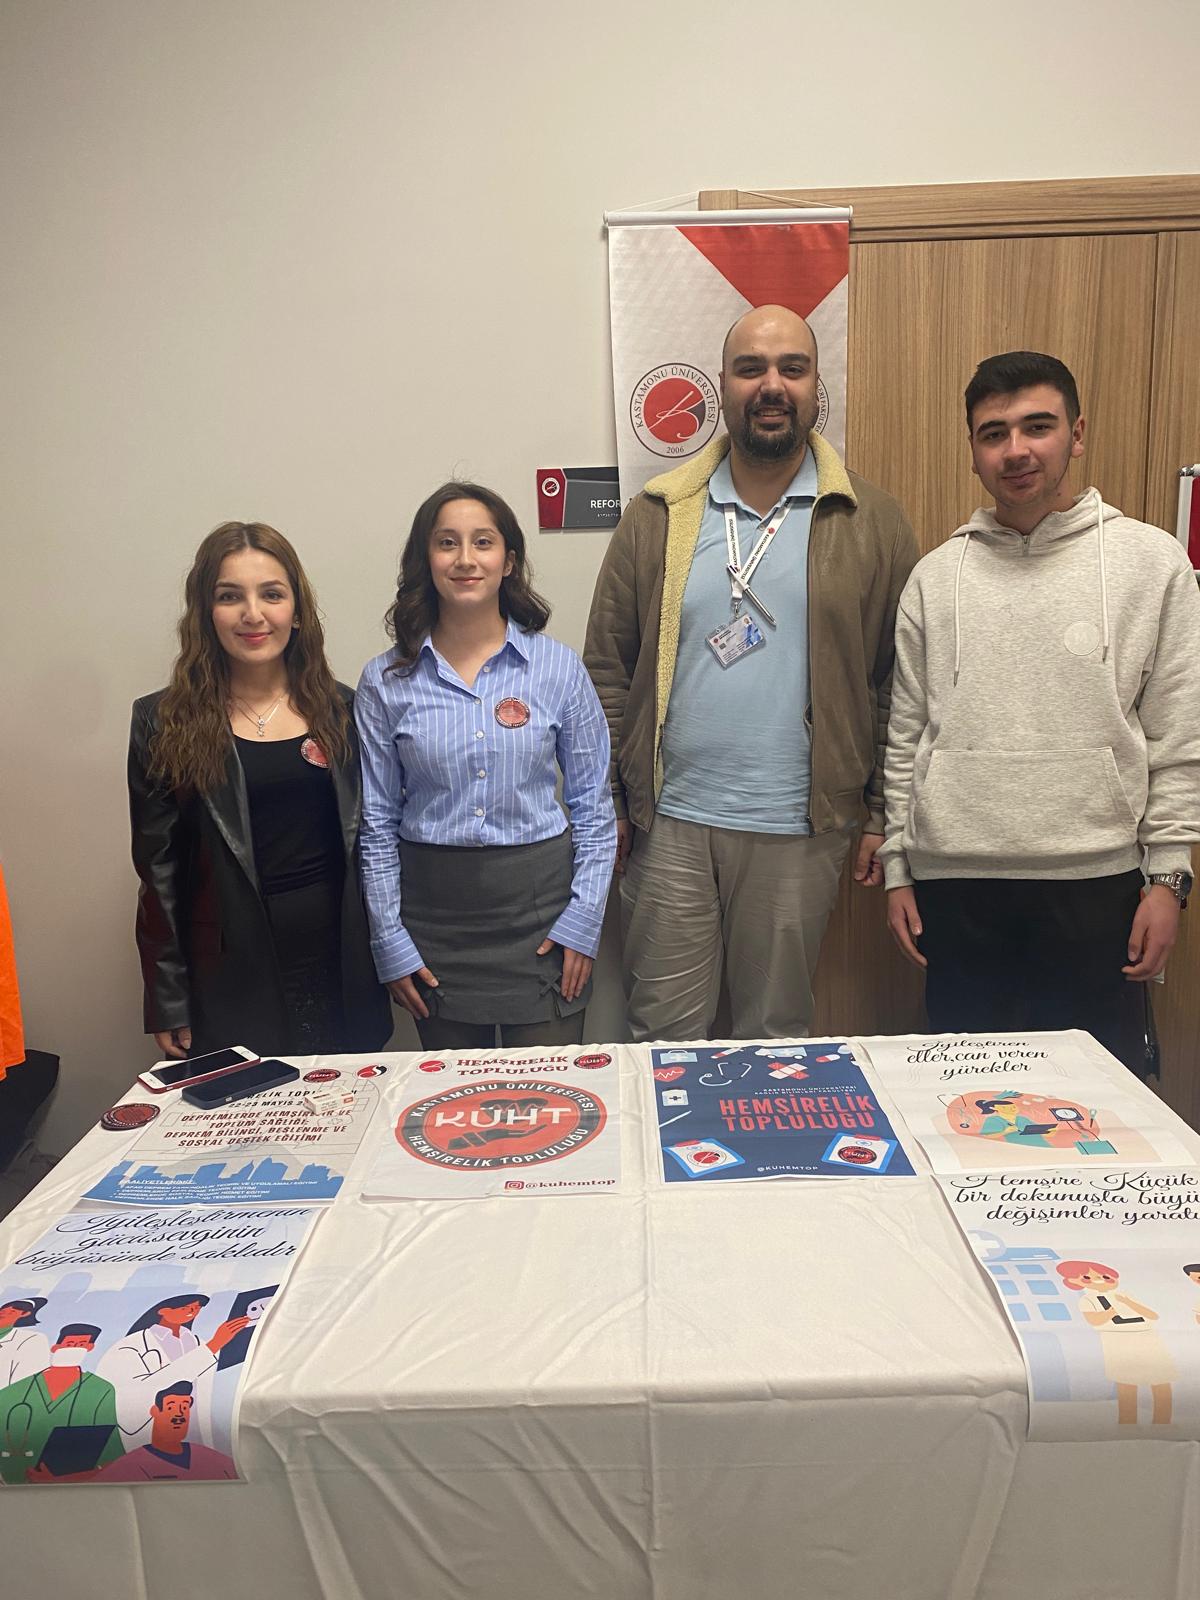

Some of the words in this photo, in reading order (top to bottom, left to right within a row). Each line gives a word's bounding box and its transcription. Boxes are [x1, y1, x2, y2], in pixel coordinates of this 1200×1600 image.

[634, 369, 668, 428] KASTAMONU
[671, 366, 715, 423] ÜNİVERSİTESİ
[666, 446, 685, 454] 2006
[998, 1050, 1048, 1058] veren
[940, 1060, 1031, 1080] yürekler
[410, 1083, 497, 1117] KASTAMONU
[181, 1112, 262, 1121] DEPREMLERDE
[209, 1120, 256, 1128] TOPLUM
[164, 1130, 213, 1138] DEPREM
[227, 1135, 271, 1144] DESTEK
[409, 1134, 491, 1167] HEMŞİRELİK
[500, 1128, 588, 1164] TOPLULUĞU
[525, 1180, 615, 1189] @kuhemtop
[1090, 1171, 1198, 1191] Küçük
[955, 1189, 991, 1203] bir
[1000, 1188, 1128, 1206] dokunuşla
[987, 1204, 1114, 1226] değişimler
[15, 1246, 177, 1271] büyüsünde
